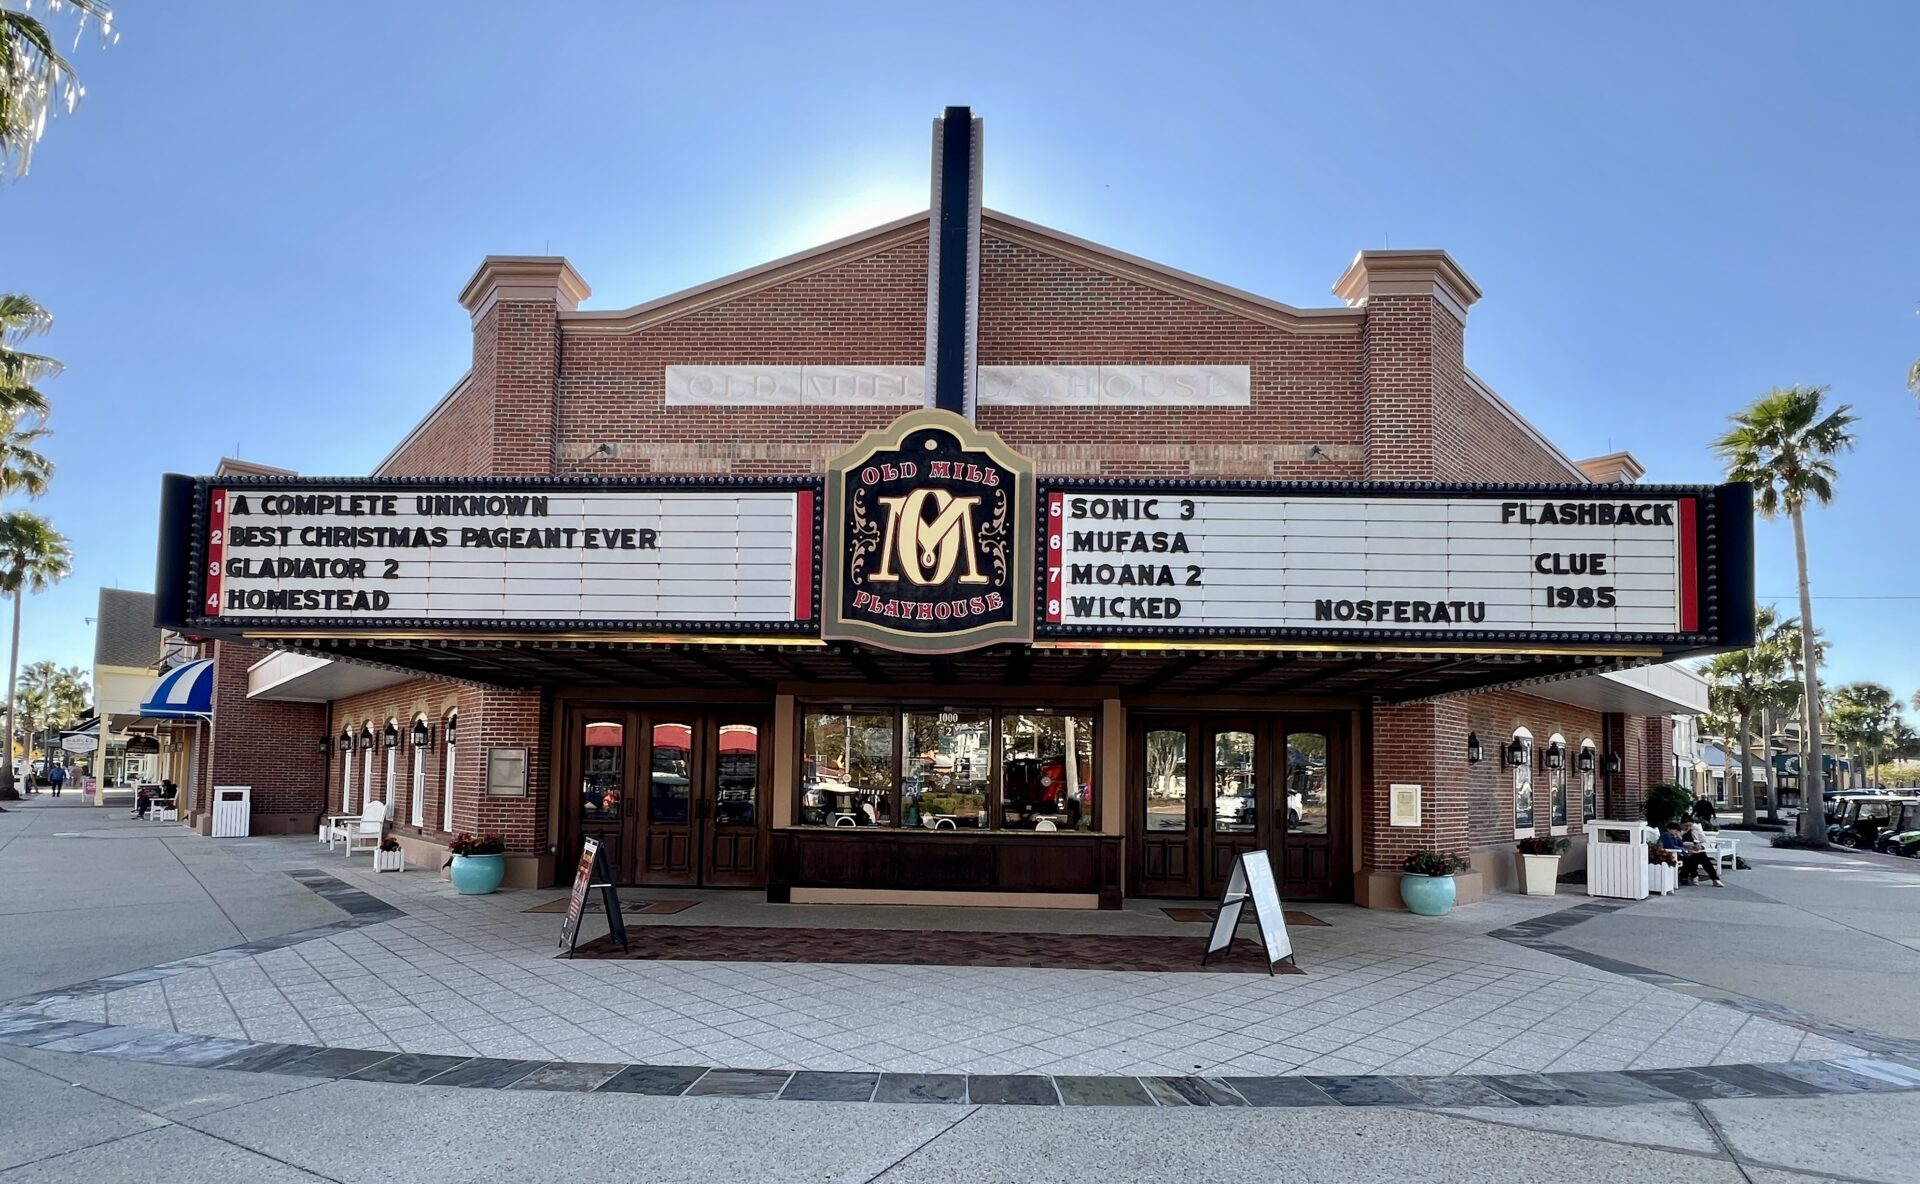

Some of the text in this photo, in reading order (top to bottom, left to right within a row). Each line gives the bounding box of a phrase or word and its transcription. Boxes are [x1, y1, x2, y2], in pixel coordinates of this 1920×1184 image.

[687, 375, 1229, 398] OLD MILL LAYHOUSE
[861, 460, 1000, 487] OLD MILL
[213, 494, 548, 517] 1 A COMPLETE UNKNOWN
[1050, 498, 1195, 521] 5 SONIC 3
[1501, 502, 1674, 526] FLASHBACK
[210, 526, 657, 550] 2 BEST CHRISTMAS PAGEANT EVER
[1049, 530, 1190, 554] 6 MUFASA
[208, 557, 399, 579] 3 GLADIATOR 2
[1049, 563, 1202, 587] 7 MOANA 2
[1534, 552, 1607, 576] CLUE
[207, 589, 390, 611] 4 HOMESTEAD
[852, 590, 1004, 620] PLAYHOUSE
[1048, 596, 1182, 619] 8 WICKED
[1546, 585, 1617, 609] 1985
[1315, 599, 1486, 624] NOSFERATU
[938, 712, 959, 723] 1000
[945, 727, 952, 736] 2
[1045, 726, 1052, 736] 3
